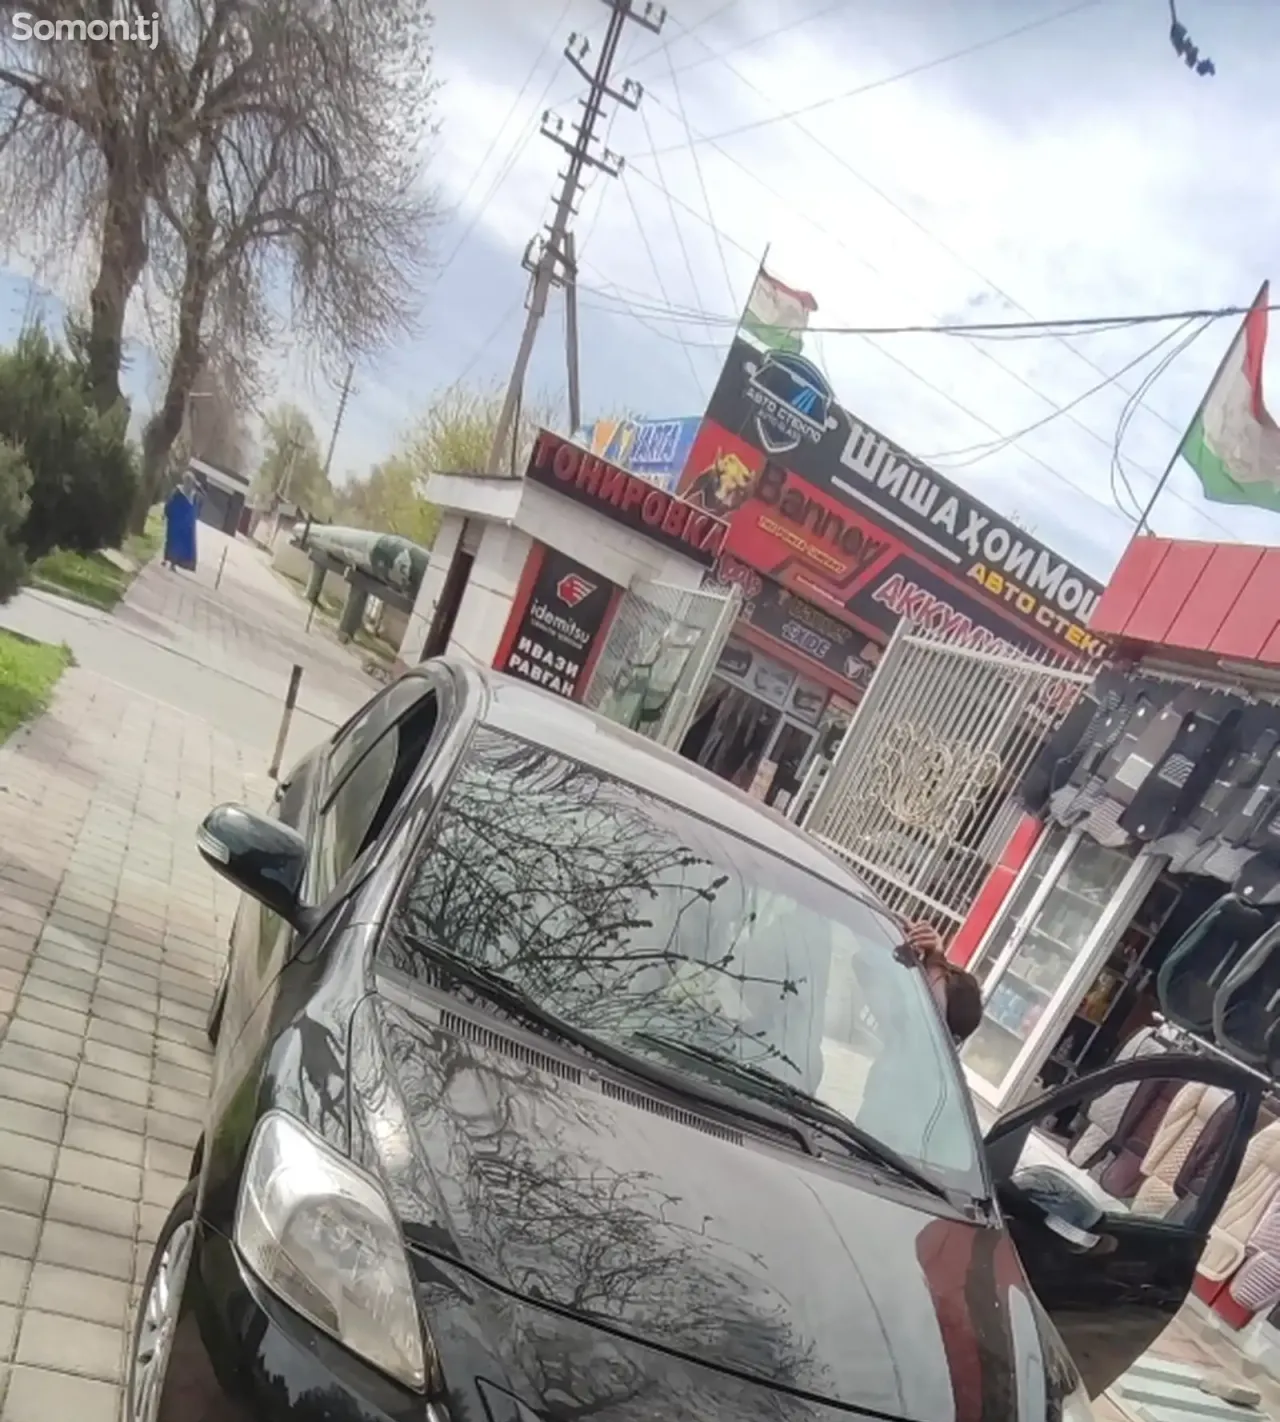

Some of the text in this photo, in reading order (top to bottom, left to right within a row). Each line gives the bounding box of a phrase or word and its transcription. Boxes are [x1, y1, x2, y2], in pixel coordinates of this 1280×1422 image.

[534, 431, 727, 557] ТОНИРОВКА
[966, 562, 1037, 614] АВТО
[530, 598, 591, 644] idemitsu
[517, 635, 580, 679] ИВАЗИ
